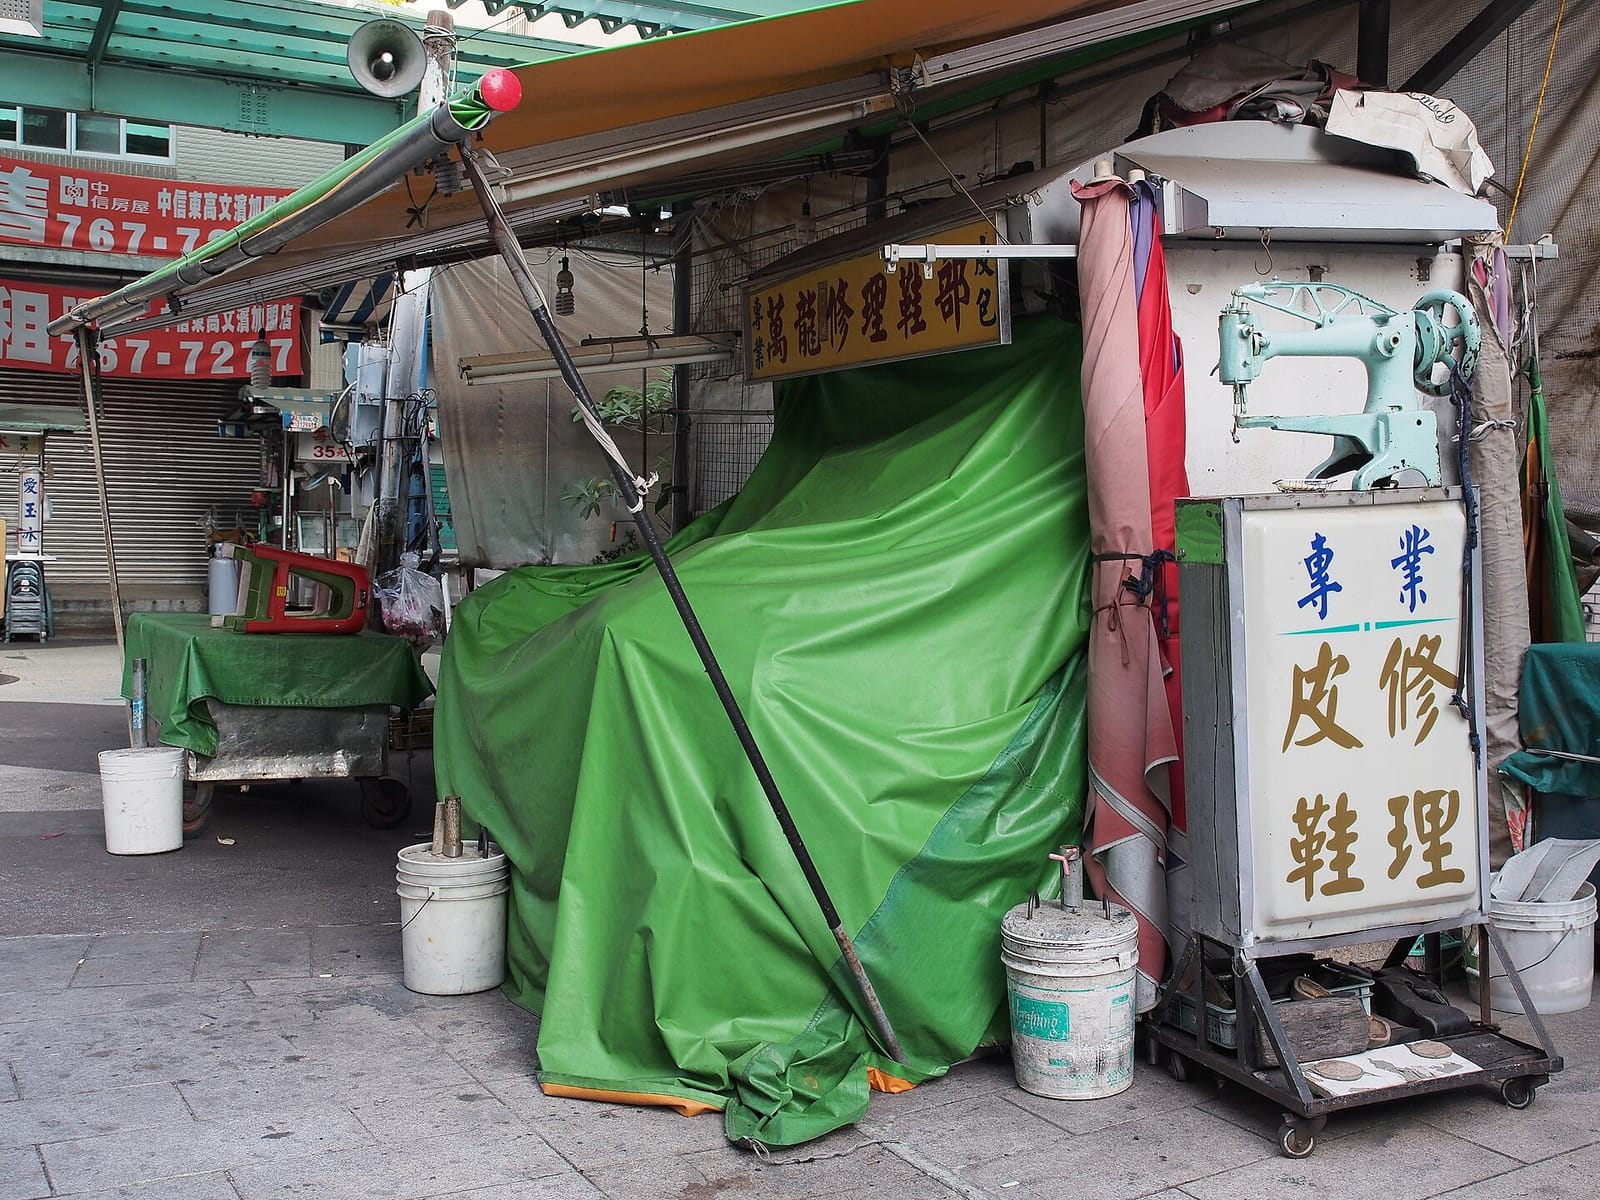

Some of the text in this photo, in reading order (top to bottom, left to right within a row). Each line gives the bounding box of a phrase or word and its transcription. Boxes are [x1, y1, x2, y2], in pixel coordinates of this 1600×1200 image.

[90, 181, 150, 214] 中信房屋
[157, 187, 287, 222] 中信東高文濱加
[752, 296, 765, 370] 專業
[60, 334, 293, 375] 767-7277
[1297, 524, 1435, 620] 專業
